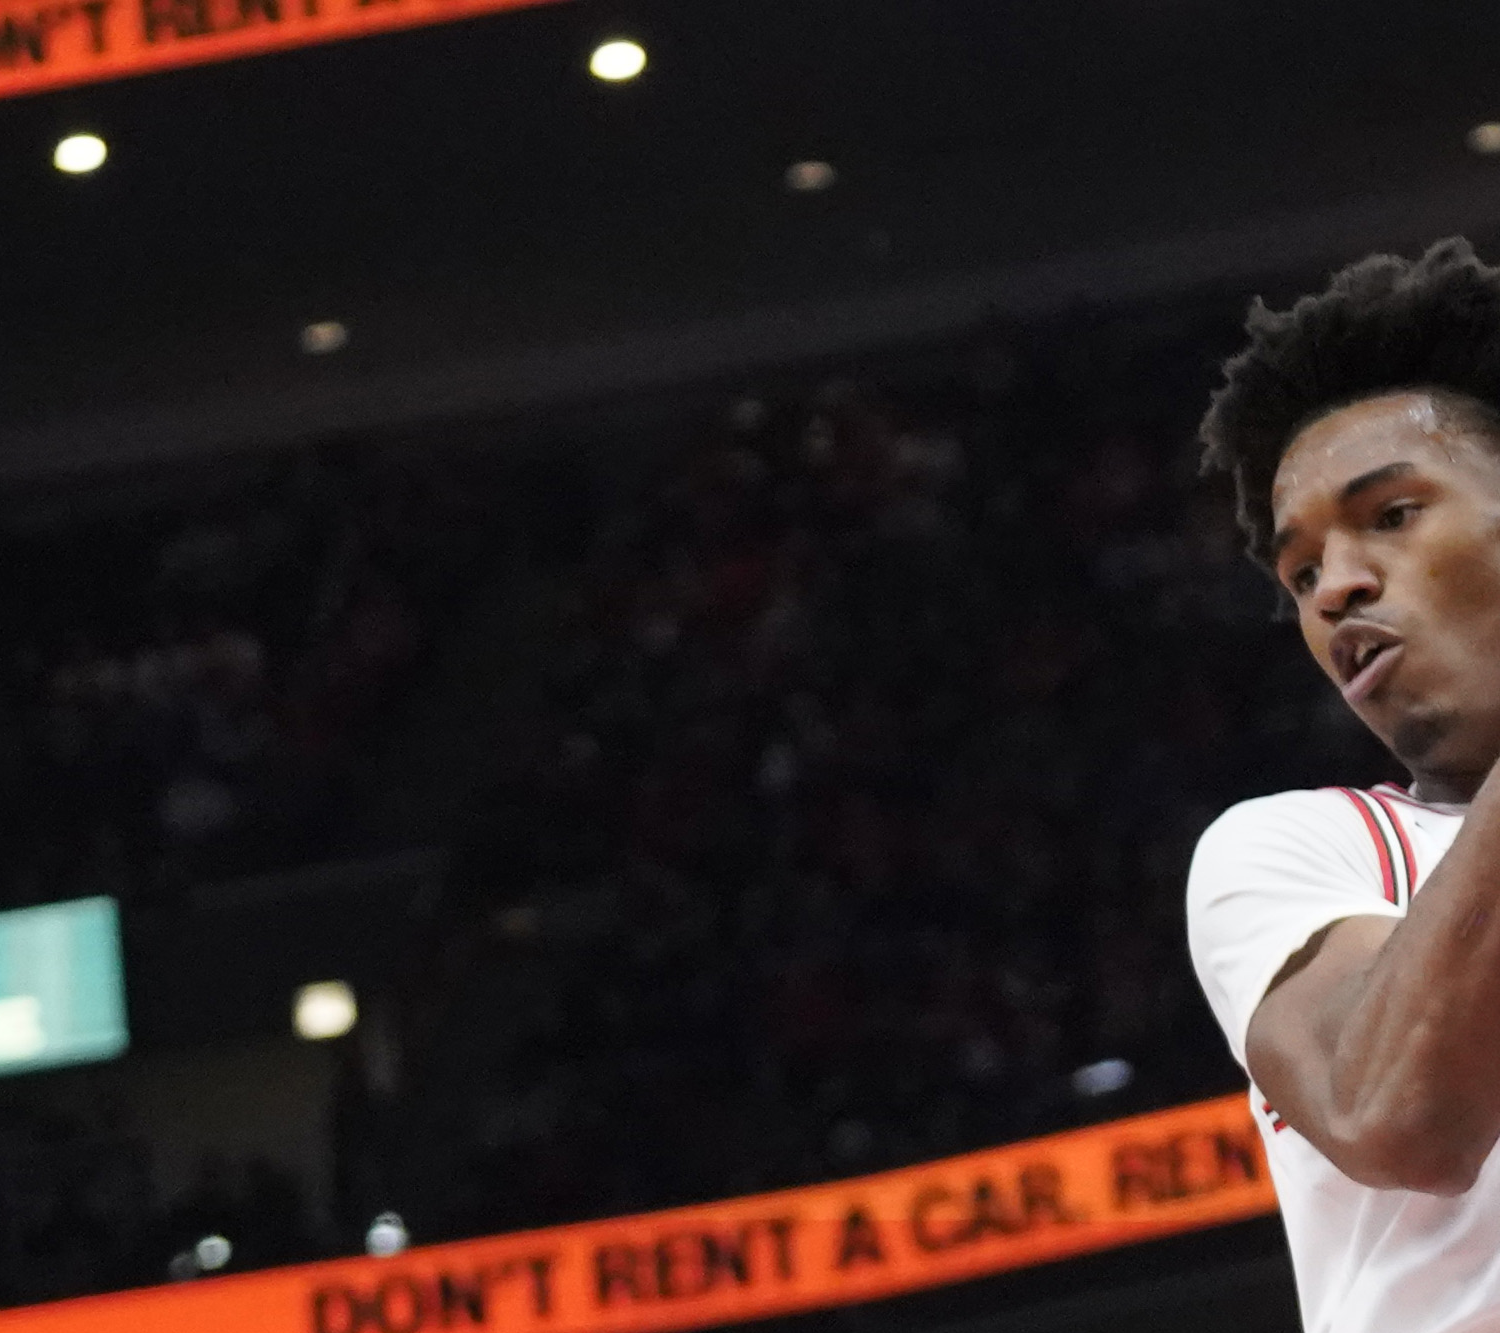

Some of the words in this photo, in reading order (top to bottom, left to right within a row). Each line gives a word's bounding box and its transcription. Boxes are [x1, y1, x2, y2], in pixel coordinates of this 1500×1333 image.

[594, 1214, 801, 1308] RENT
[834, 1208, 884, 1275] A
[913, 1163, 1092, 1256] CAR.
